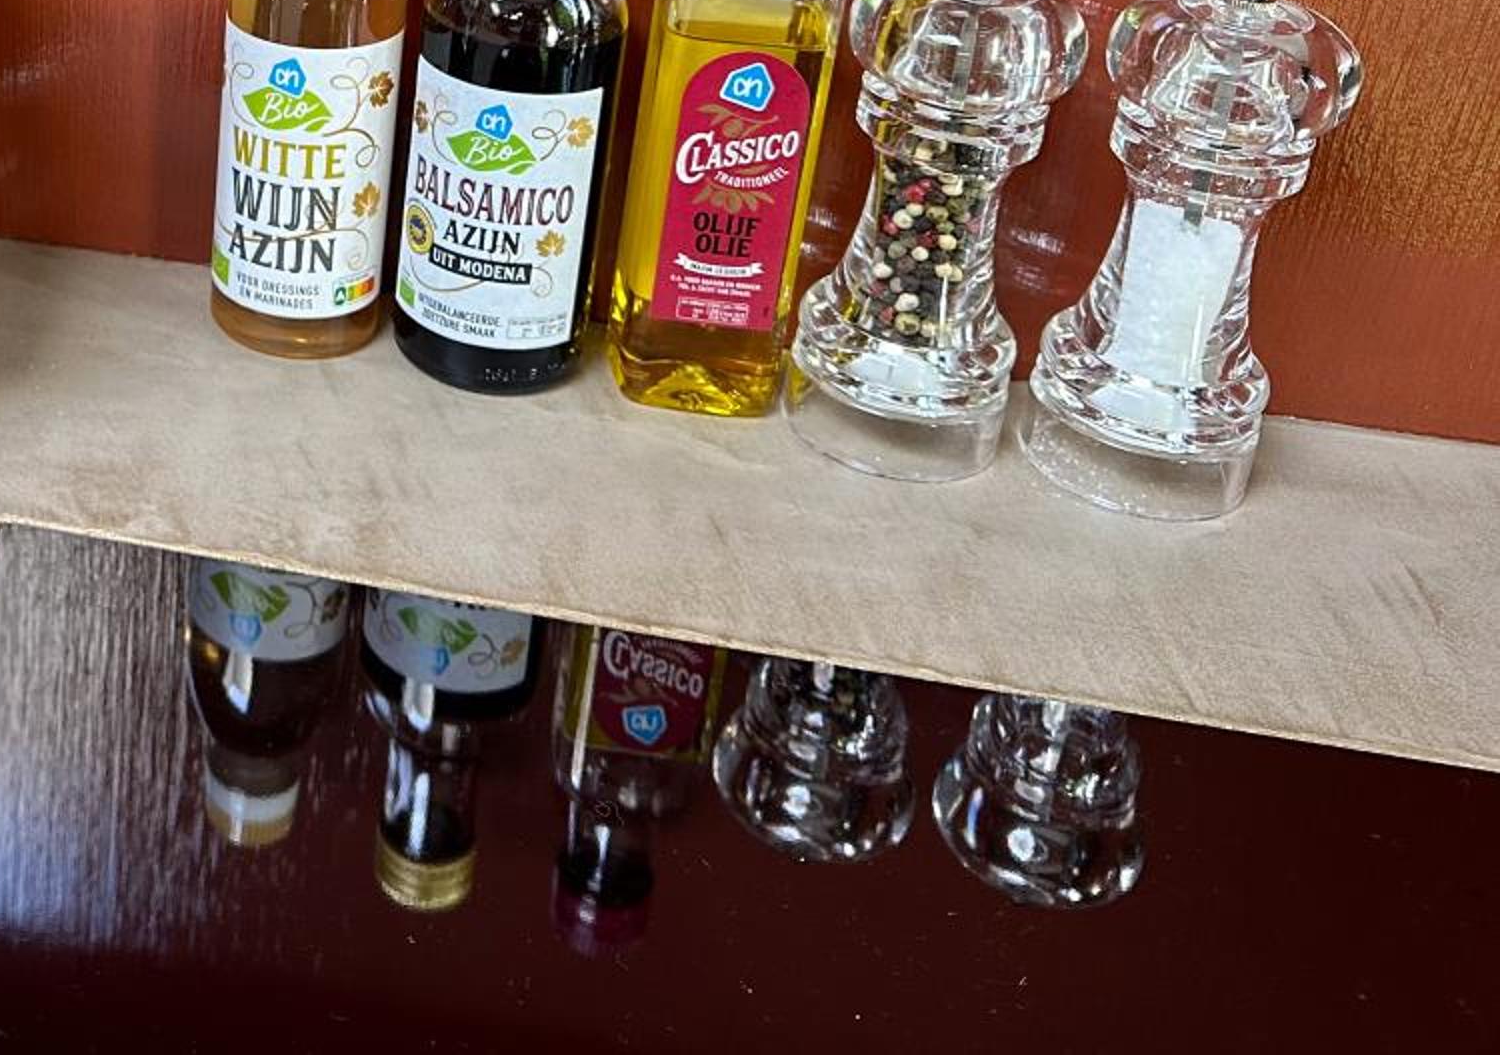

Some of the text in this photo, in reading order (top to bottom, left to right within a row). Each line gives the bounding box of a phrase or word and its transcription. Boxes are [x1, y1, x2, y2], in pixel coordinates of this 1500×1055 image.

[259, 91, 320, 124] Bio
[233, 125, 347, 181] WITTE
[462, 136, 525, 165] Bio
[231, 167, 342, 232] WIJN
[414, 155, 575, 227] BALSAMICO
[442, 219, 521, 256] AZIJN
[693, 211, 762, 239] OLIJF
[229, 222, 338, 274] AZIJN
[695, 233, 752, 259] OLIE
[432, 247, 527, 282] UIT MODENA
[262, 280, 320, 297] DRESSINGS
[463, 323, 496, 339] SMAAK
